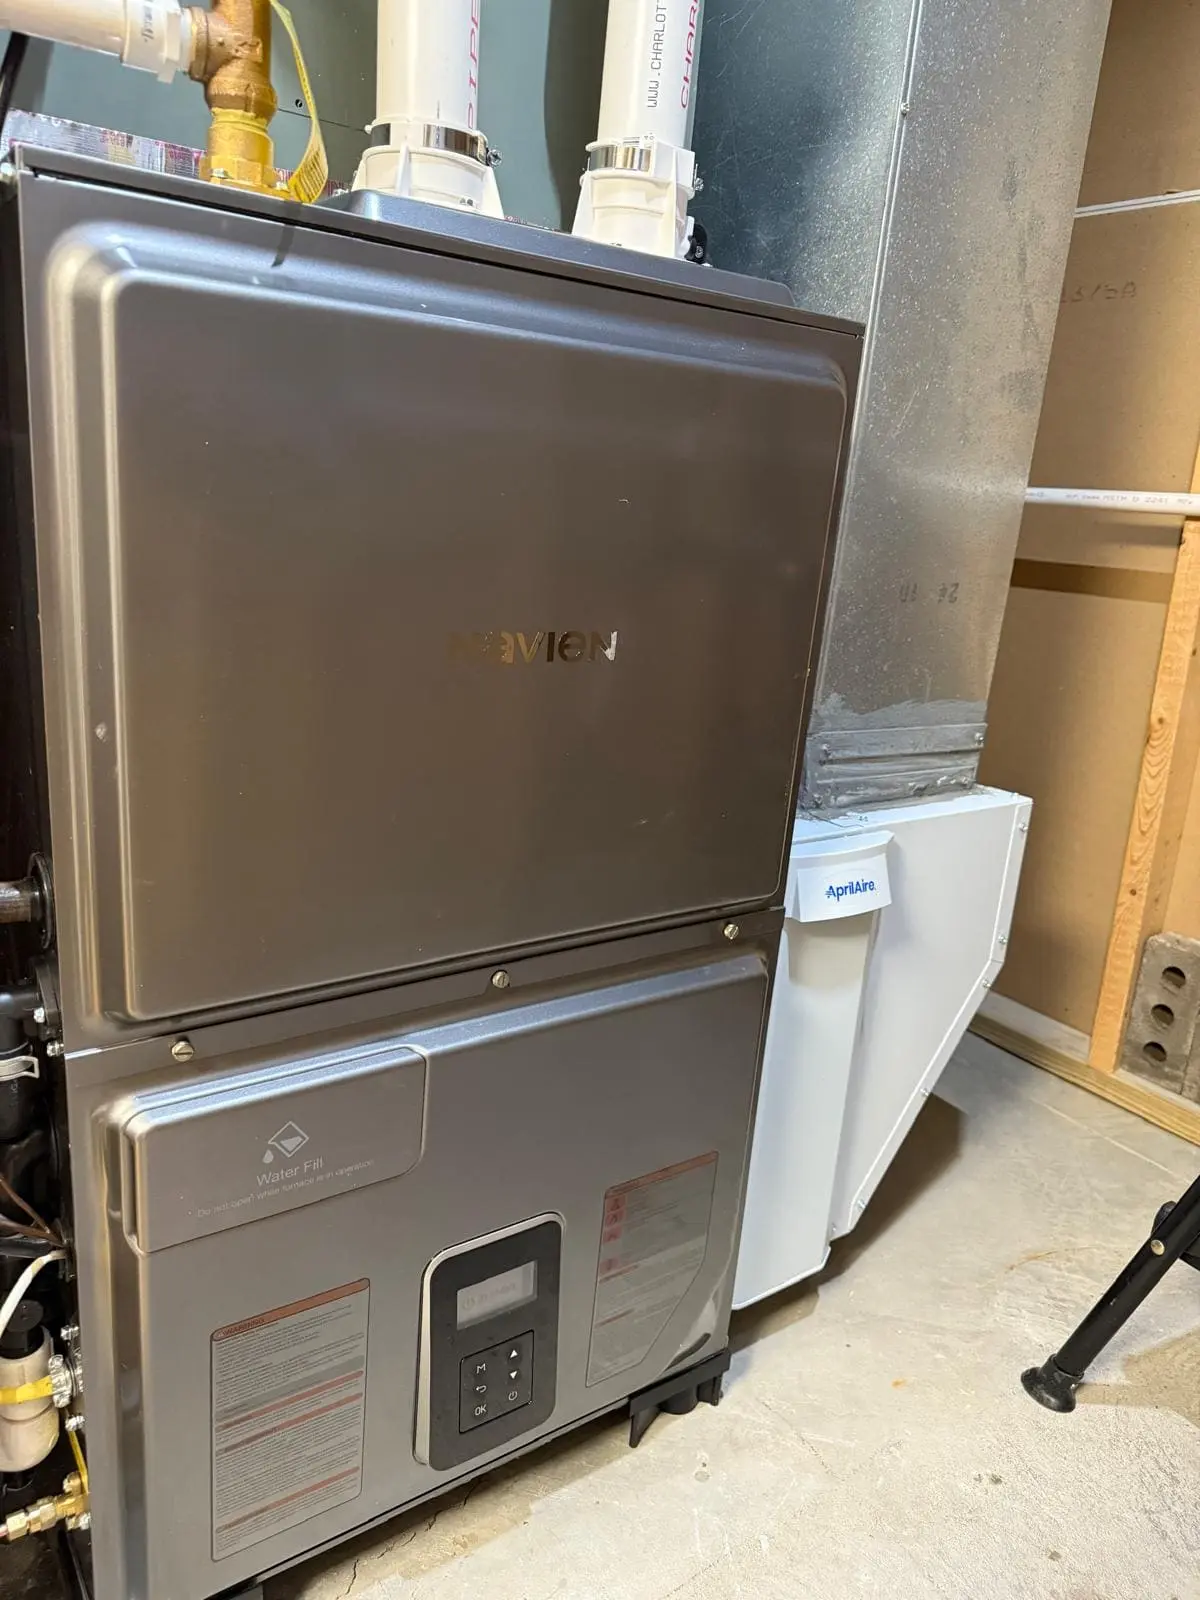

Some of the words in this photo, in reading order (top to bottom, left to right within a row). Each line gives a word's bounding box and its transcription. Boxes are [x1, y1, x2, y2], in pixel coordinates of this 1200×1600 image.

[647, 0, 667, 108] WWW.CHARLOT
[681, 0, 699, 109] CHAR
[825, 879, 875, 902] AprilAire
[257, 1166, 300, 1187] Water
[303, 1155, 323, 1173] Fill
[476, 1363, 486, 1374] M
[475, 1404, 487, 1415] OK
